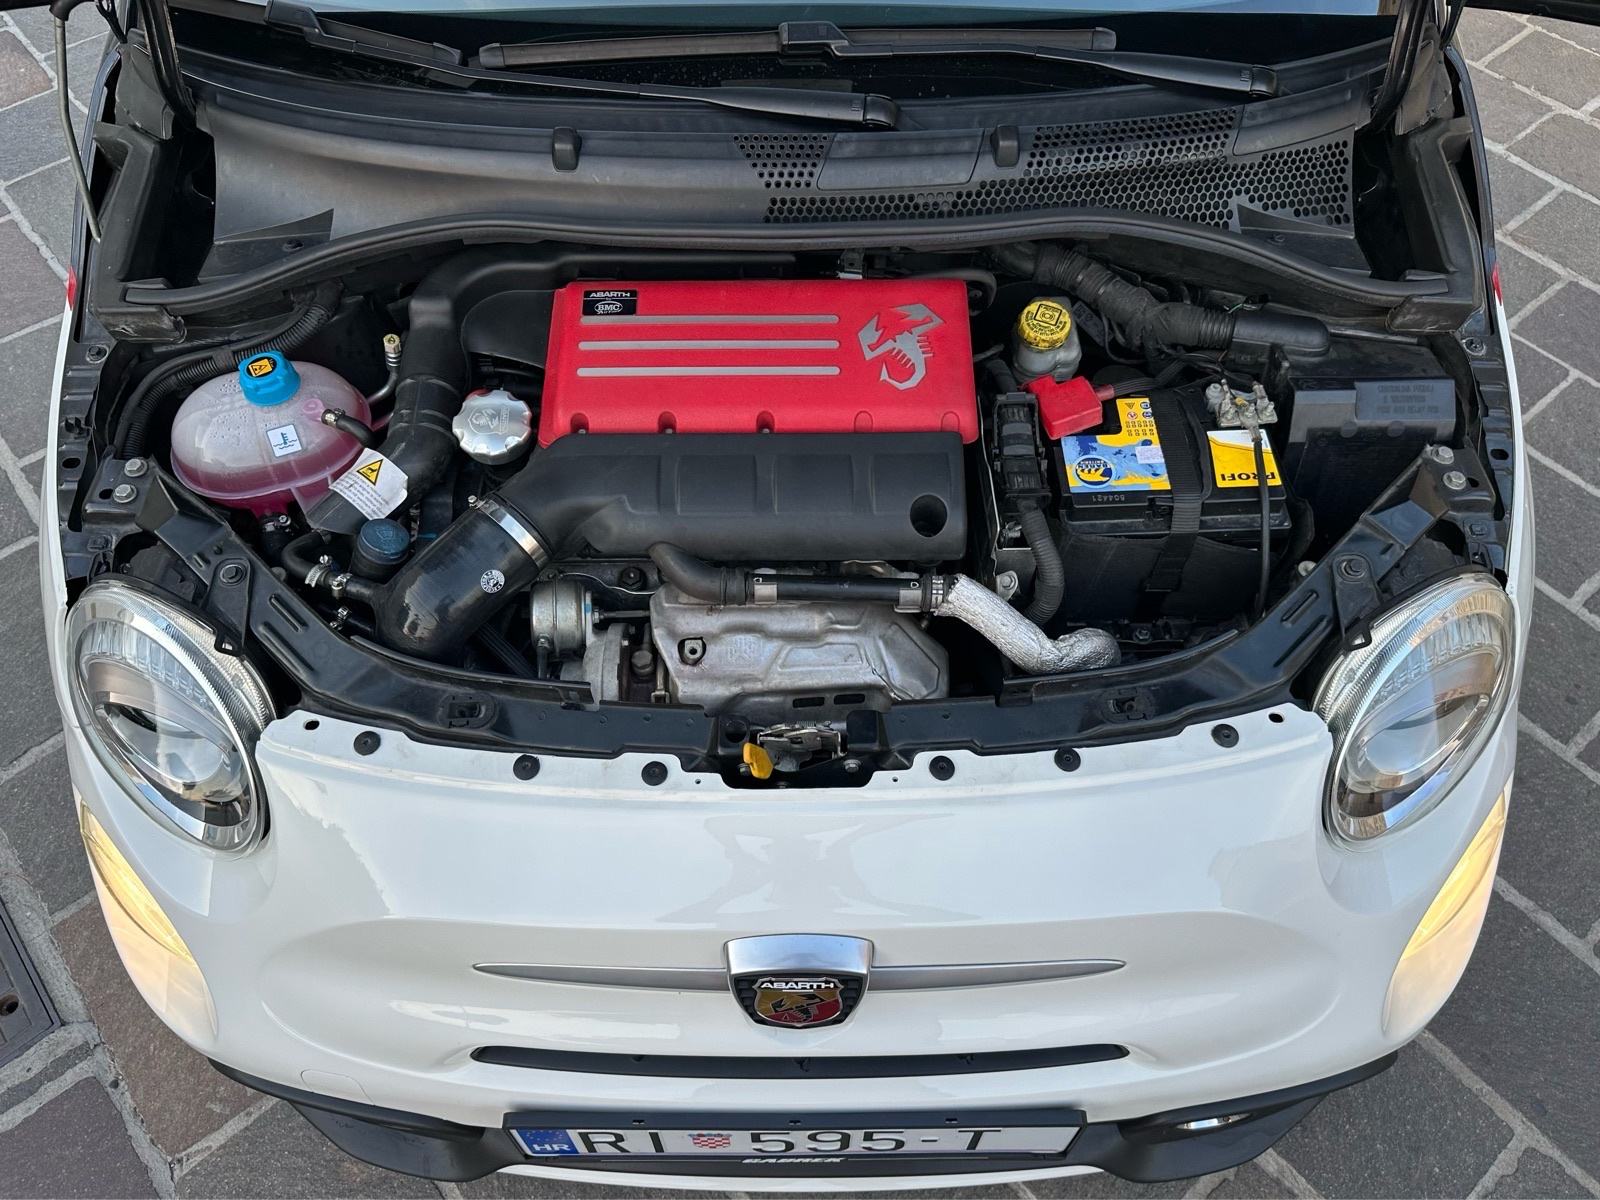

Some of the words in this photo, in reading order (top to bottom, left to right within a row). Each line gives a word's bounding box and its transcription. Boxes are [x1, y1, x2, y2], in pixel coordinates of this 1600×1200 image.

[760, 981, 835, 989] ABARTH
[577, 1131, 665, 1153] RI
[751, 1130, 1002, 1154] 595-T
